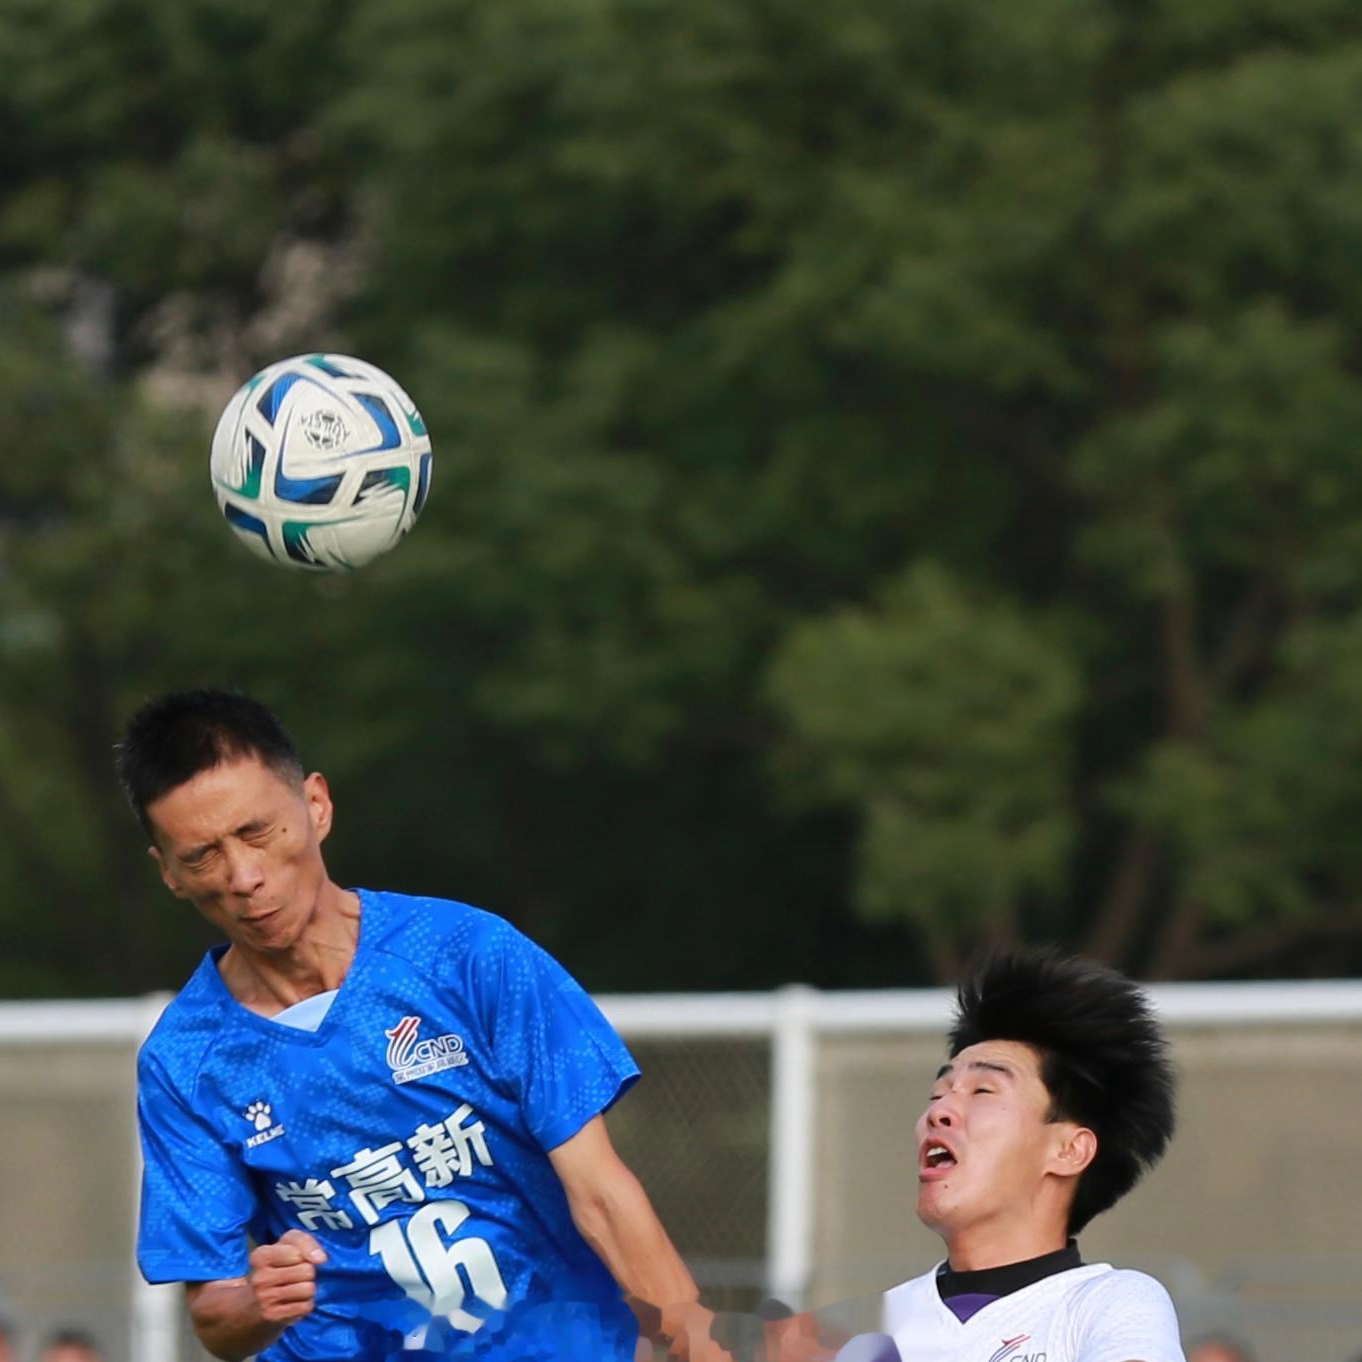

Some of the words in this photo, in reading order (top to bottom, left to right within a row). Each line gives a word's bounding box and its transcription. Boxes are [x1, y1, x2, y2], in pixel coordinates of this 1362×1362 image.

[415, 1035, 462, 1062] CND
[276, 1103, 494, 1231] 常高新
[369, 1200, 507, 1333] 16
